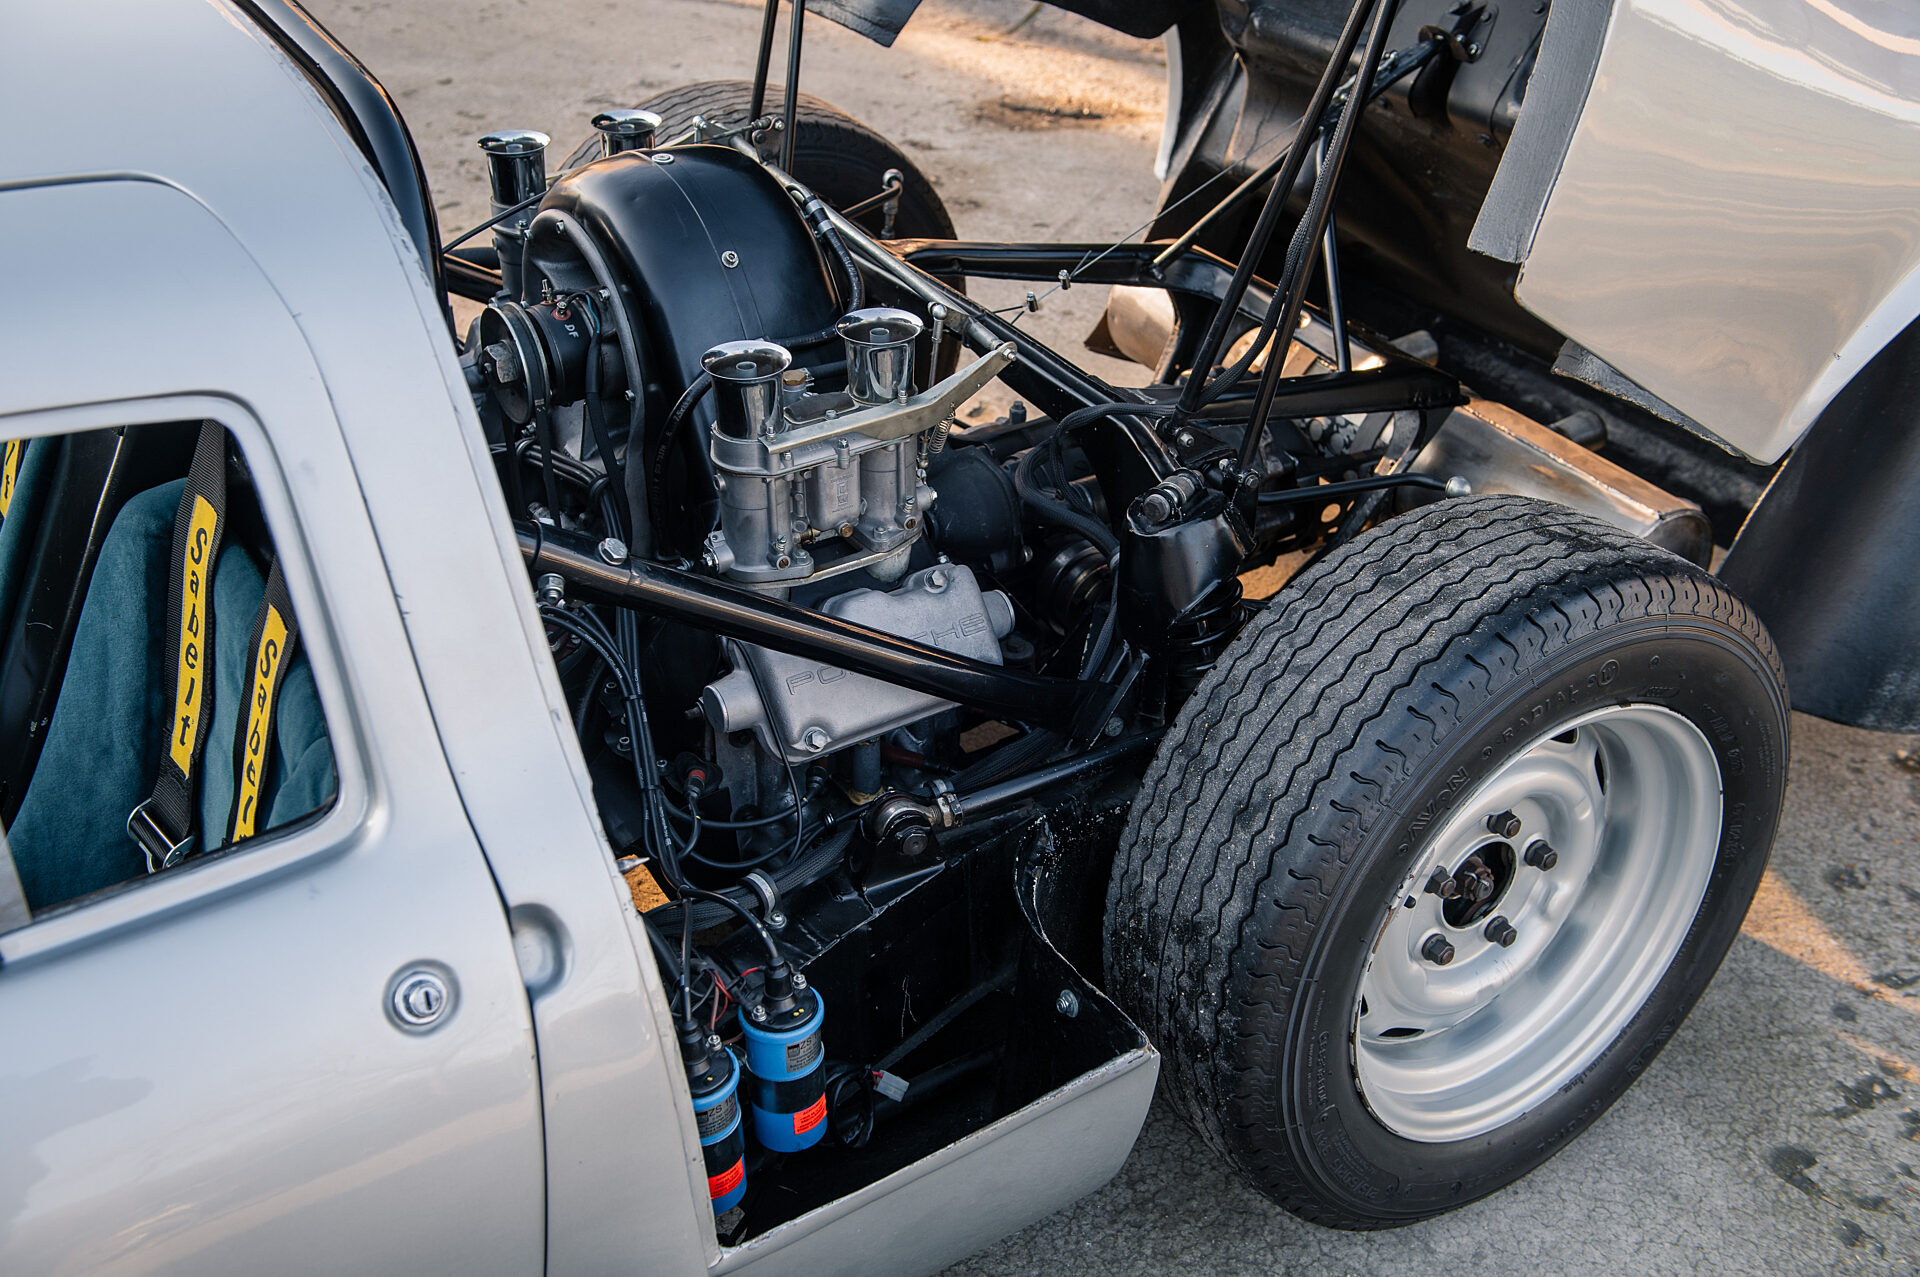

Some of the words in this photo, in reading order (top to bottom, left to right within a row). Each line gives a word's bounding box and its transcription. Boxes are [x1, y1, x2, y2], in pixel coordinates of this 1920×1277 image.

[564, 323, 580, 339] DF
[180, 527, 207, 746] Sabelt
[239, 638, 278, 839] Sabel
[708, 1104, 723, 1117] ZS
